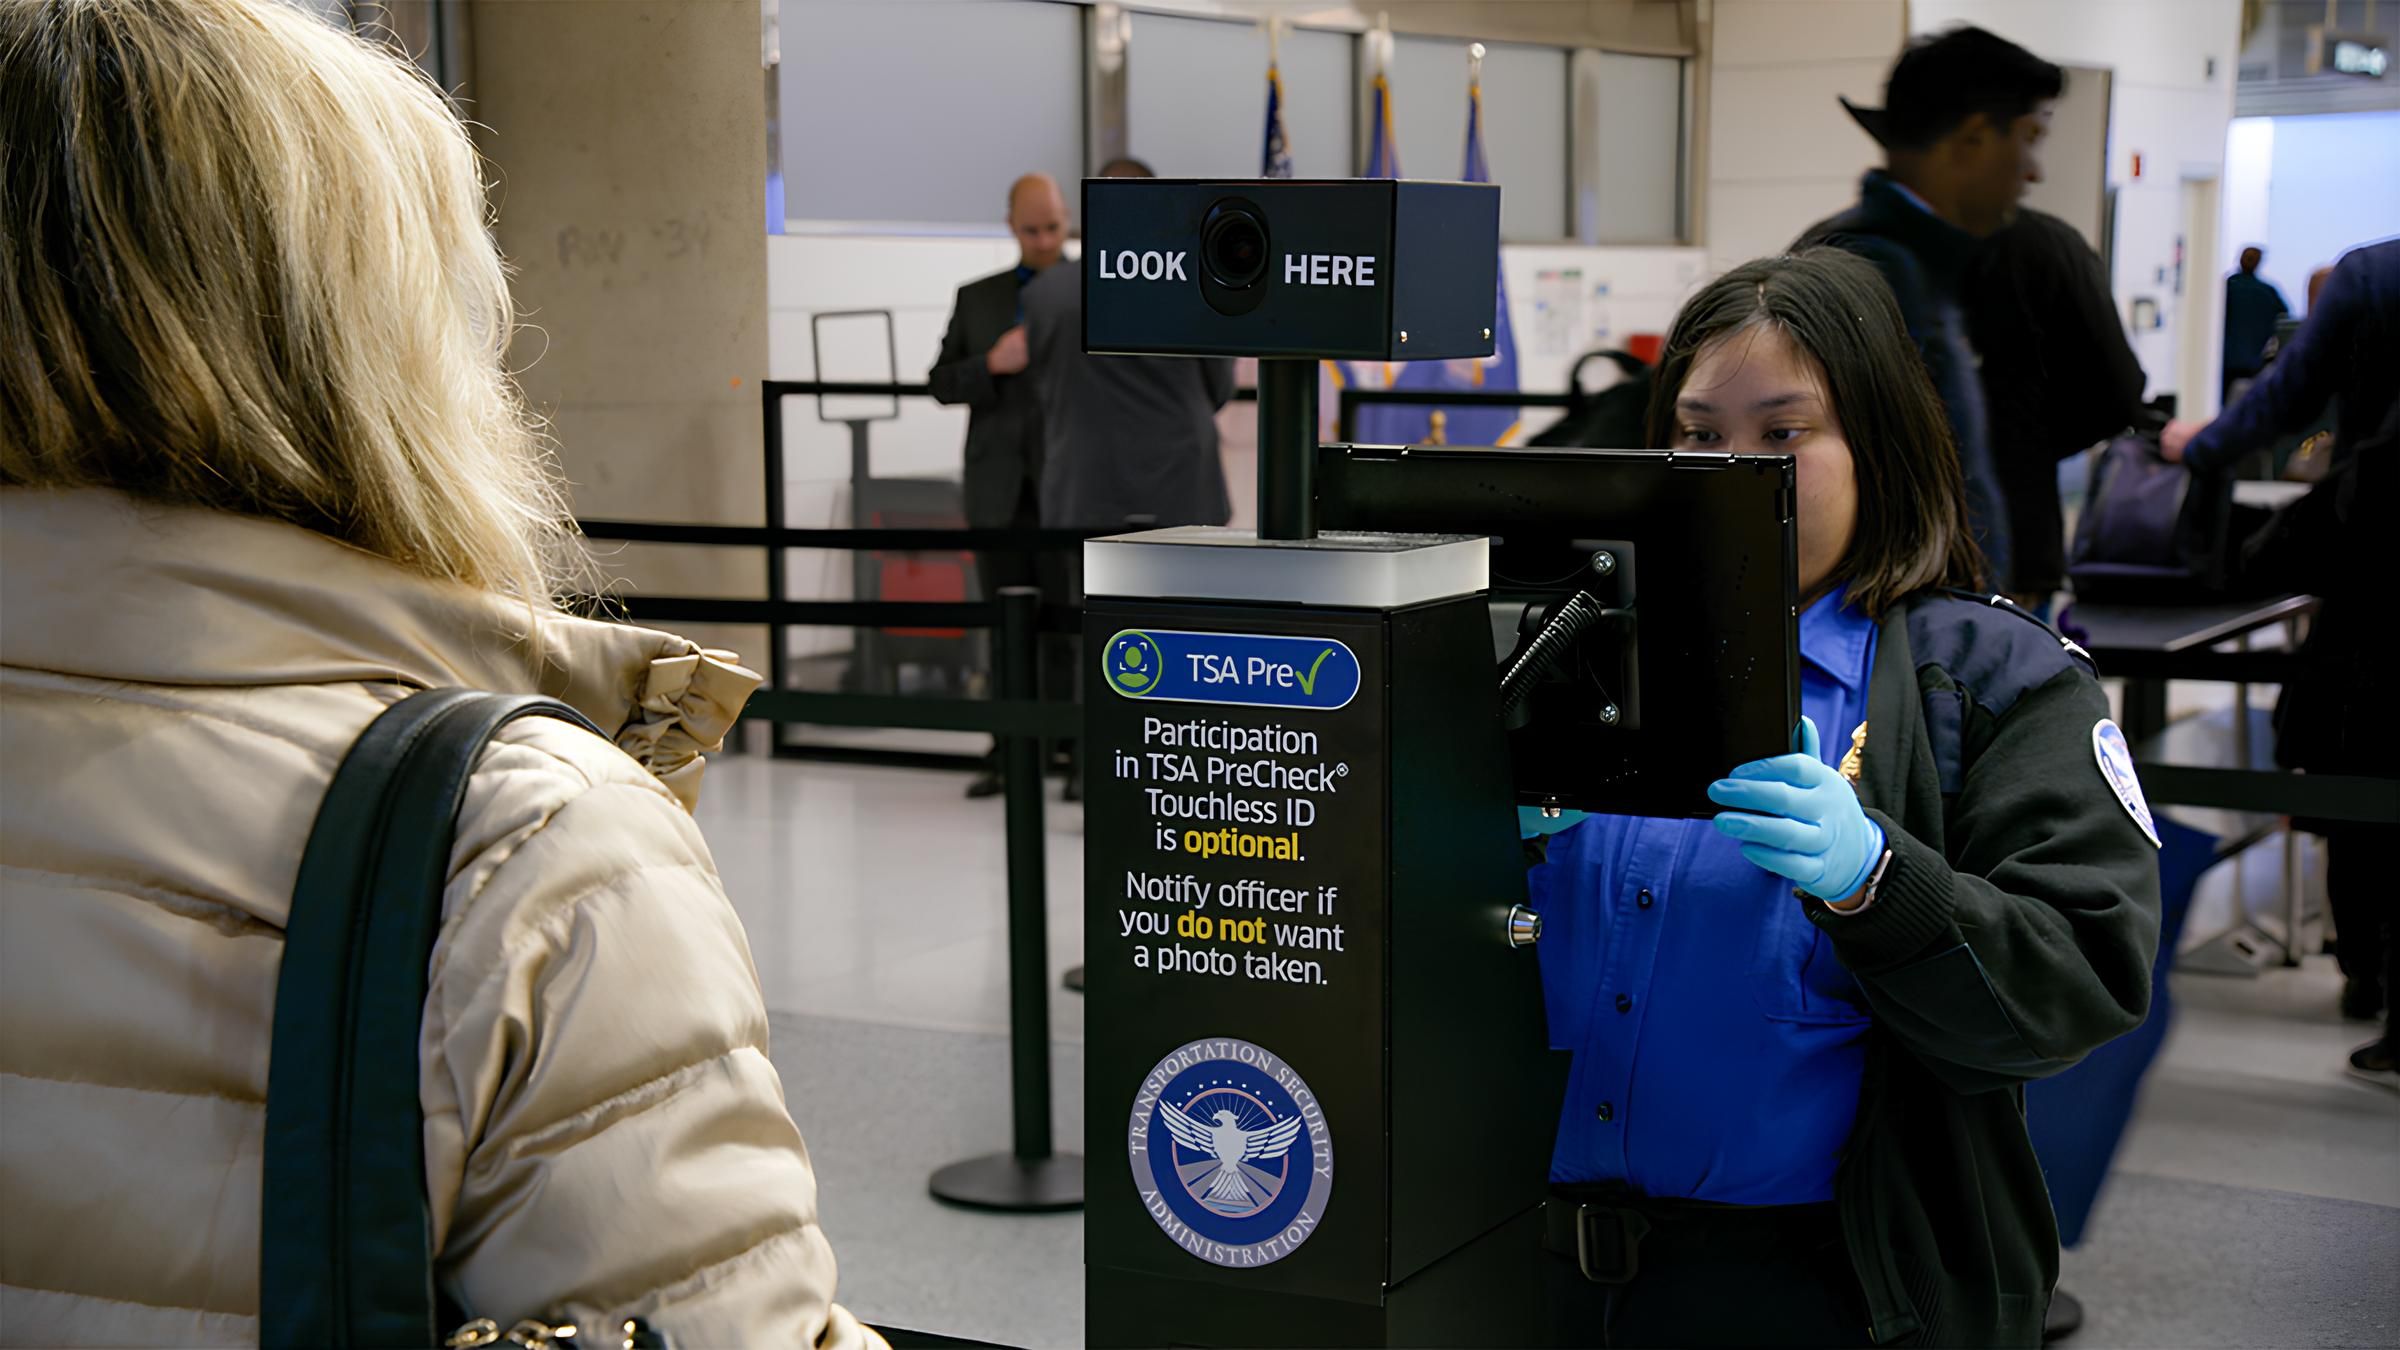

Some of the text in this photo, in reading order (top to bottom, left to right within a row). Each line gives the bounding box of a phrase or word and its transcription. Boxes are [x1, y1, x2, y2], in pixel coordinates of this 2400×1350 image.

[1100, 250, 1375, 285] LOOK HERE
[1187, 654, 1239, 683] TSA
[1144, 718, 1317, 755] Participation
[1116, 750, 1138, 778] in
[1146, 753, 1199, 782] TSA
[1145, 788, 1314, 826] Touchless ID
[1157, 822, 1305, 861] is optional.
[1128, 871, 1337, 915] Notify officer if
[1119, 908, 1344, 953] you do not want
[1134, 940, 1328, 985] a photo taken.
[1132, 1042, 1330, 1178] TRANSPORTATION SECURITY
[1142, 1190, 1315, 1265] ADMINISTRATION
